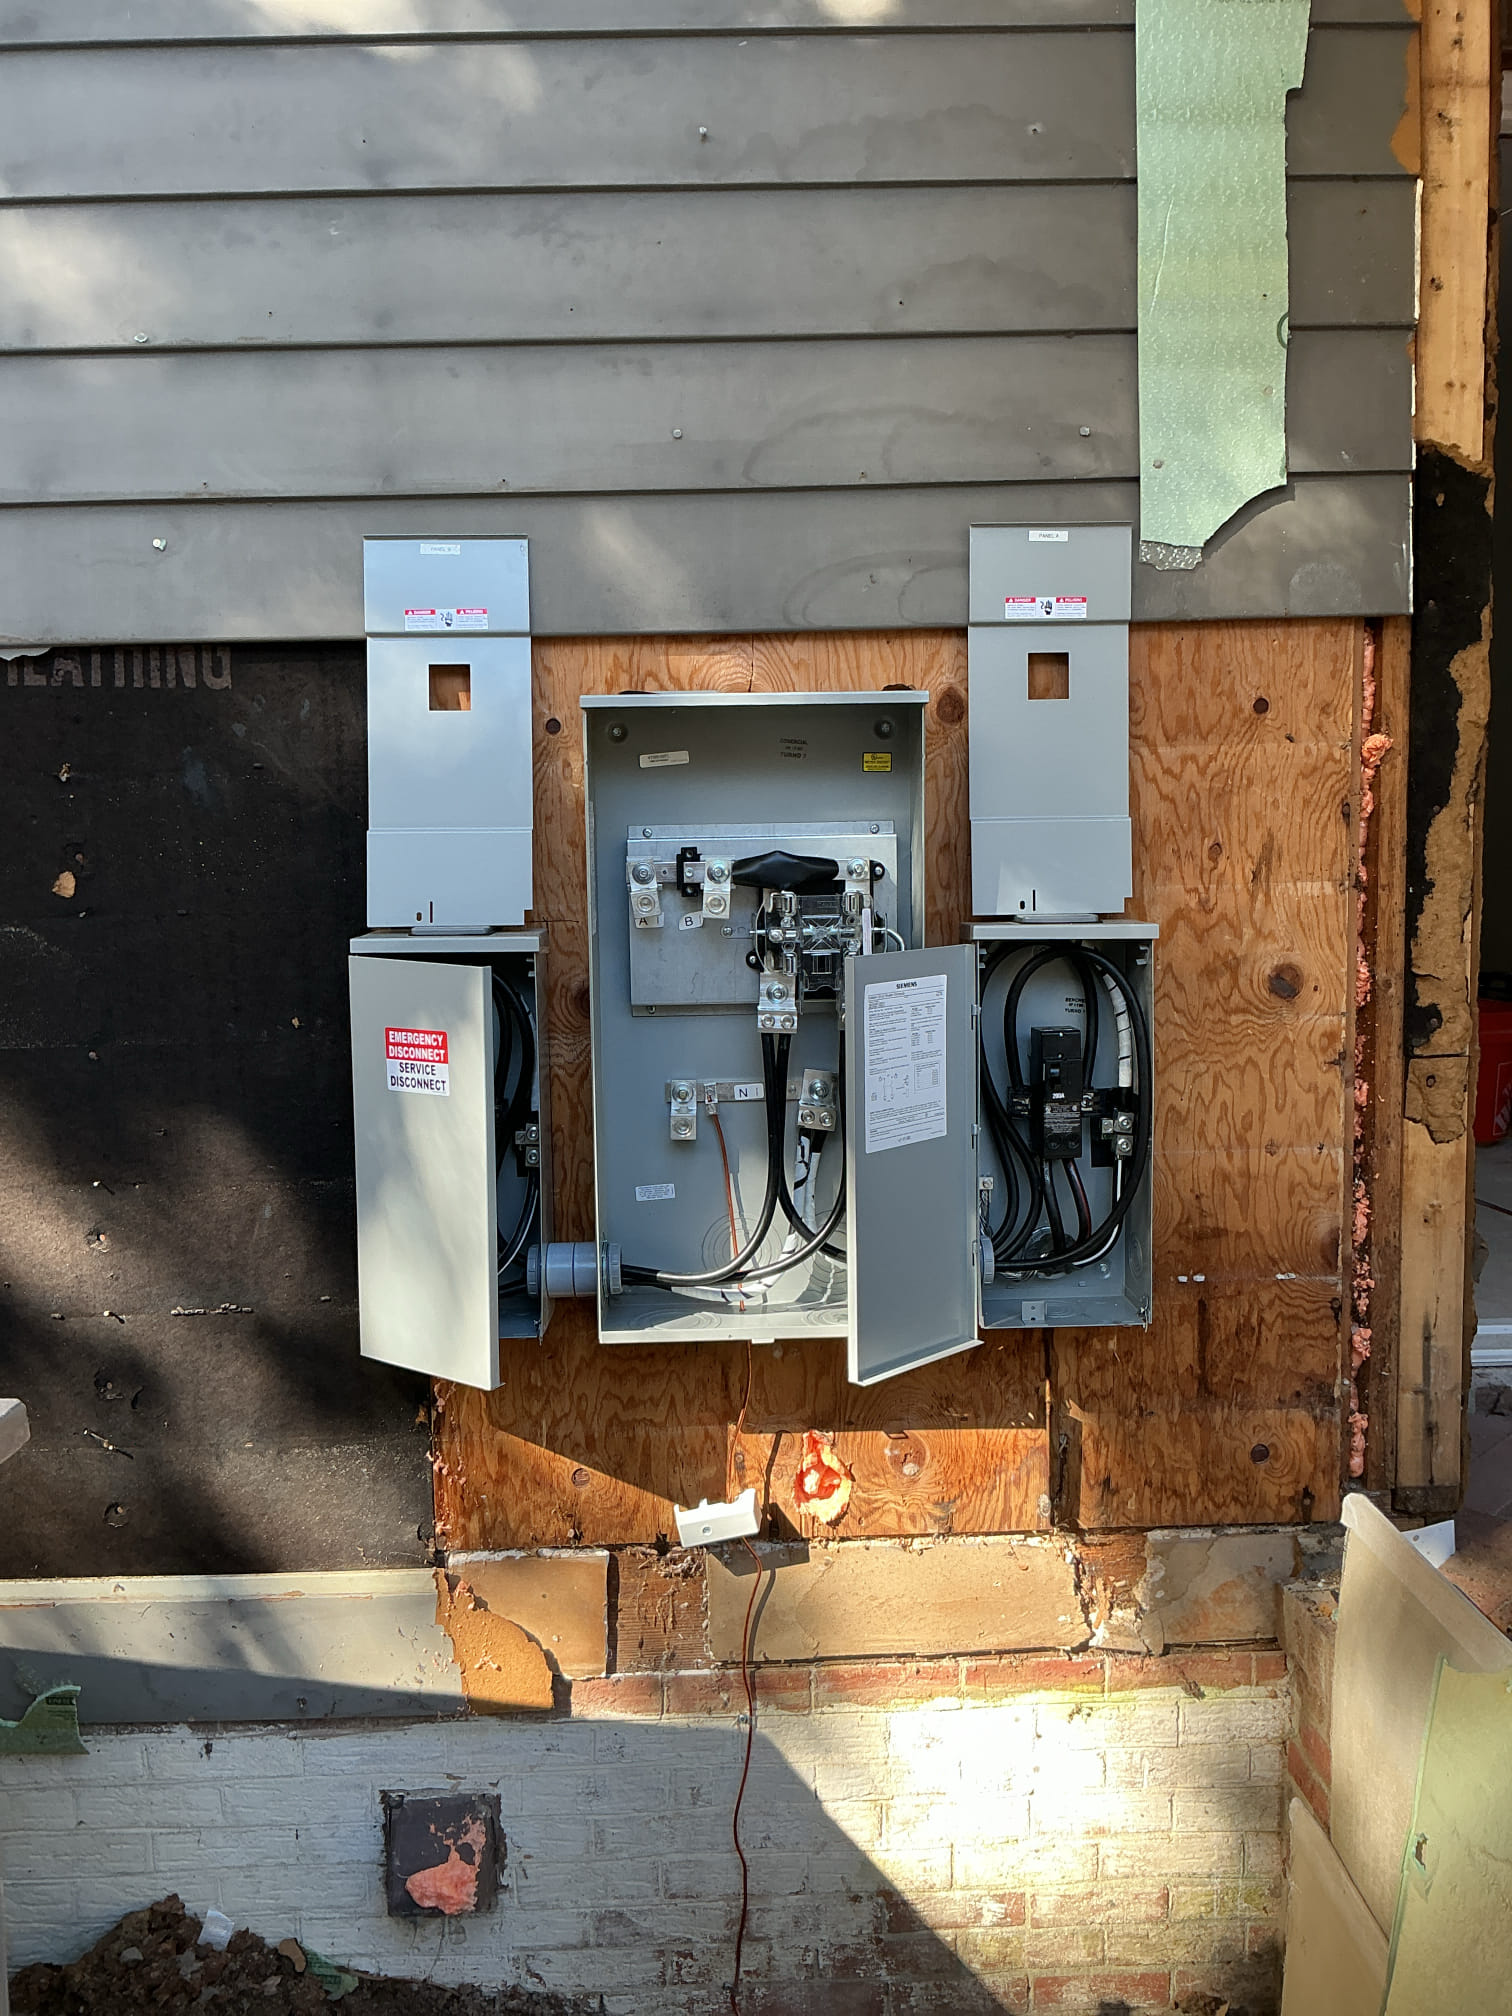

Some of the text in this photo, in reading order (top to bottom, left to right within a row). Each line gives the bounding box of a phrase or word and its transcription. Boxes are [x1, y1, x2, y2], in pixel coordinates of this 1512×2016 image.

[639, 917, 649, 926] A
[684, 916, 694, 927] B
[896, 981, 918, 989] SIEMENS
[388, 1030, 444, 1046] EMERGENCY
[388, 1045, 446, 1062] DISCONNECT
[399, 1062, 437, 1076] SERVICE
[390, 1075, 446, 1091] DISCONNECT
[739, 1088, 748, 1098] N
